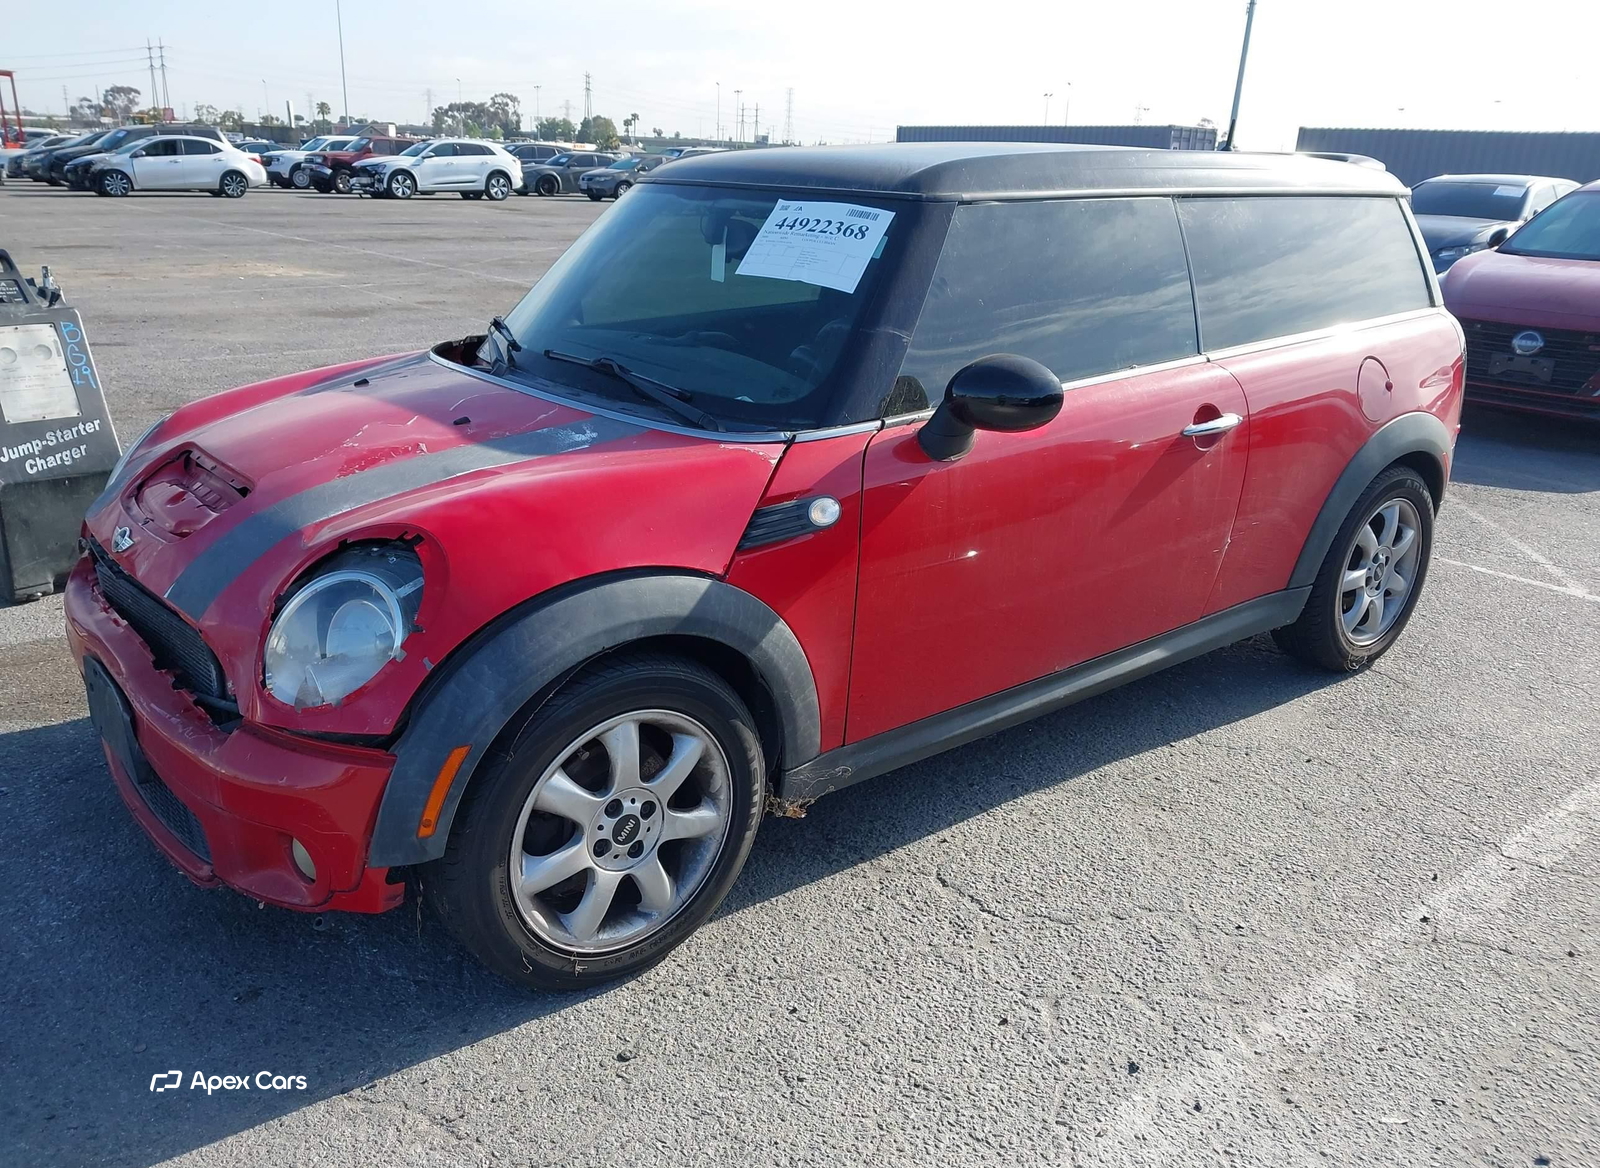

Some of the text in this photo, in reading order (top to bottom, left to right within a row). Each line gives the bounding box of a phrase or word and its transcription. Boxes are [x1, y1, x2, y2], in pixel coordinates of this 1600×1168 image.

[775, 216, 870, 241] 44922368
[0, 418, 101, 463] Jump-Starter
[25, 444, 87, 475] Charger
[617, 818, 636, 842] MINI
